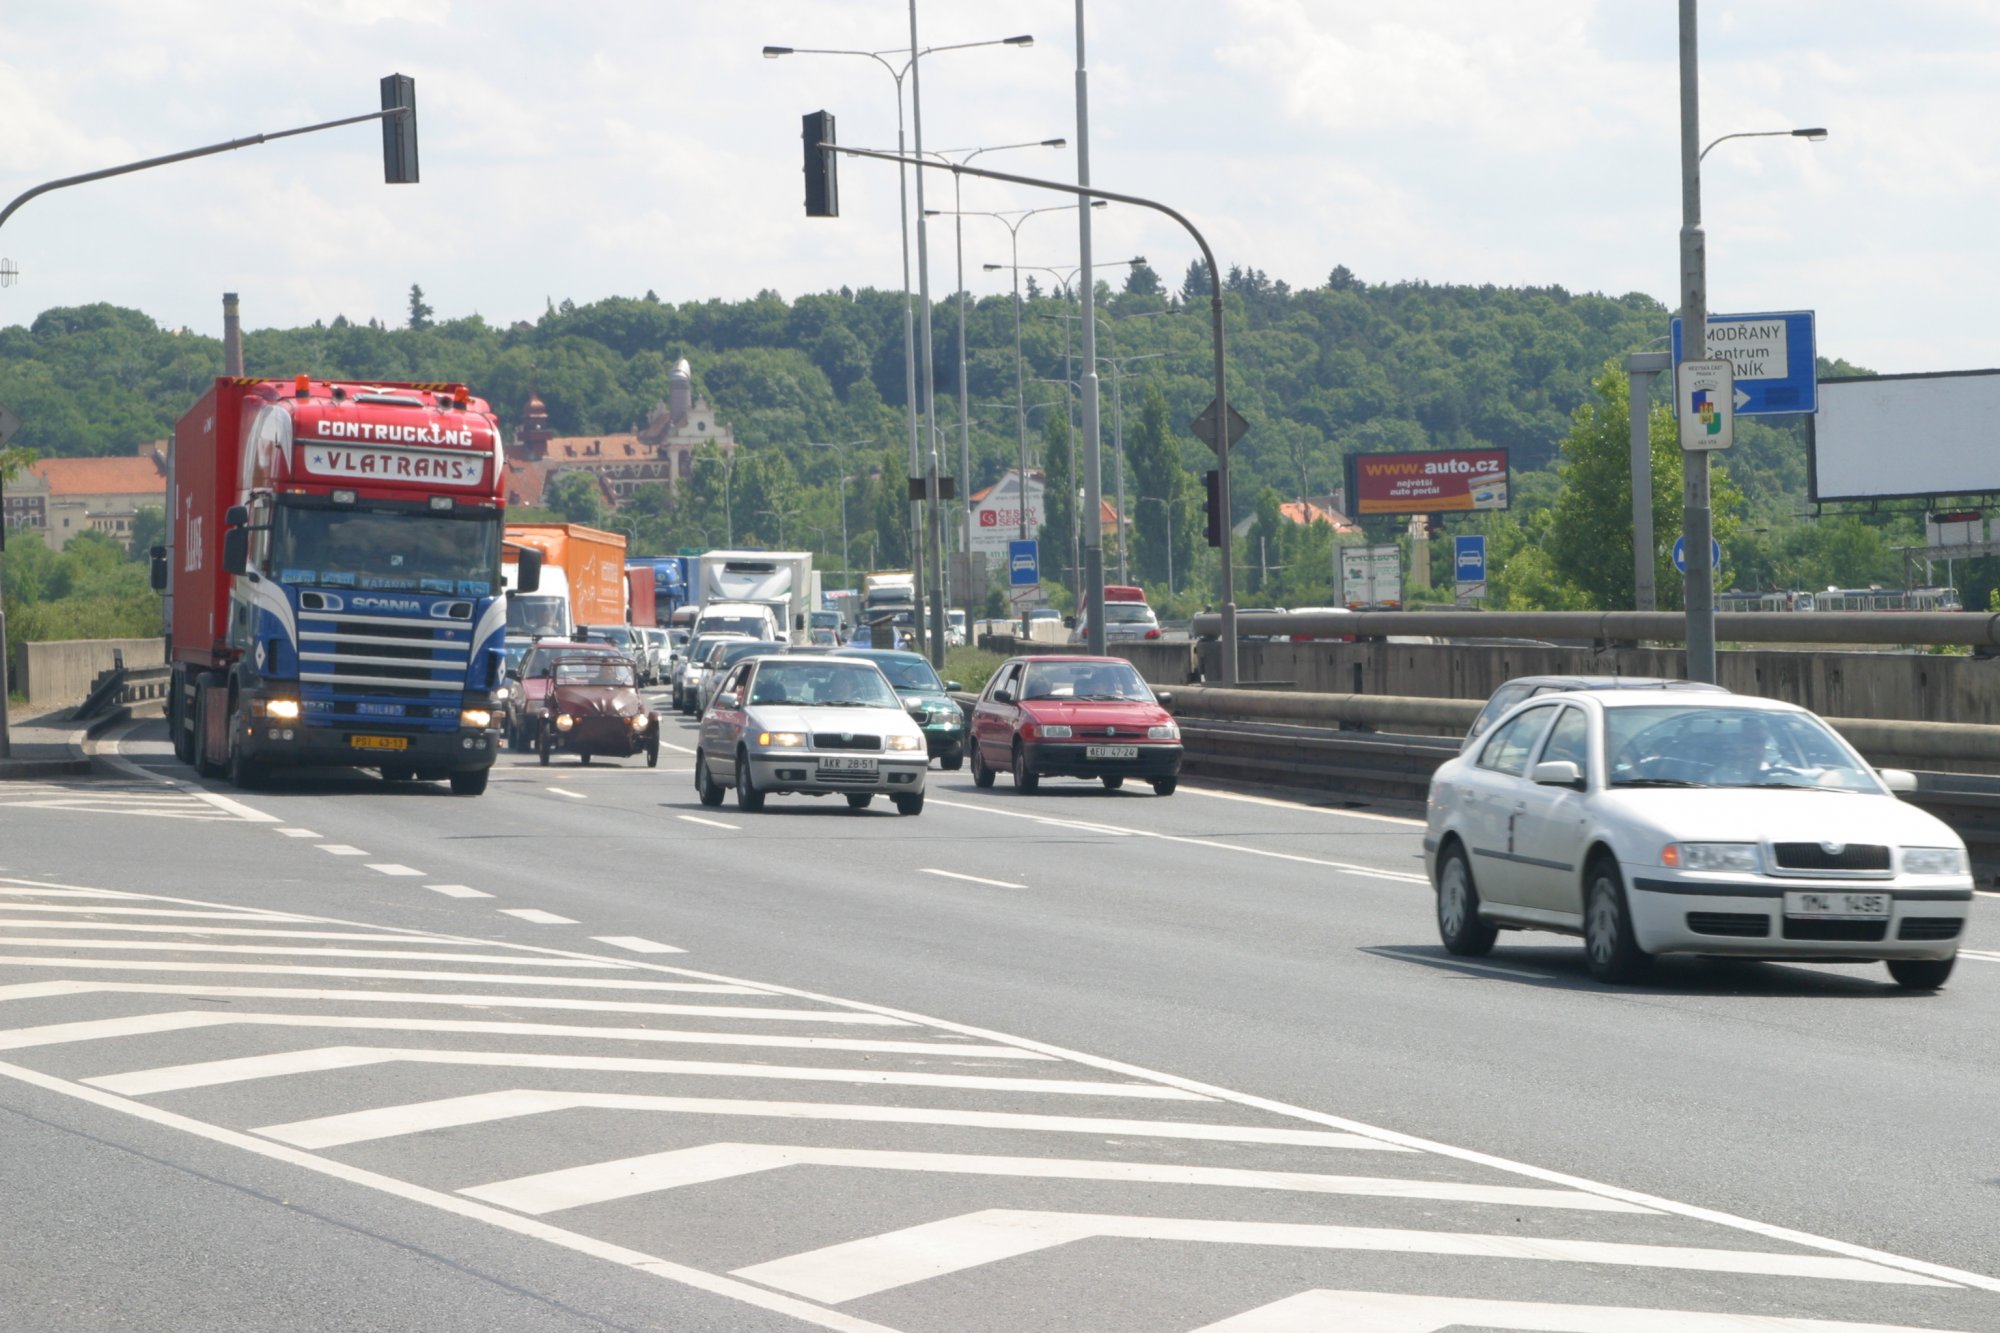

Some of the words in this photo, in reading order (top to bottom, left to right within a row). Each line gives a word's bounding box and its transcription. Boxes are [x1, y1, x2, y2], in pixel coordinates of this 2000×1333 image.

[1706, 325, 1780, 341] MODŘANY
[317, 420, 472, 446] CONTRUCKING
[327, 451, 463, 479] VLATRANS
[1366, 458, 1499, 476] www.auto.cz
[352, 598, 420, 612] SCANIA
[848, 760, 873, 769] 28-51
